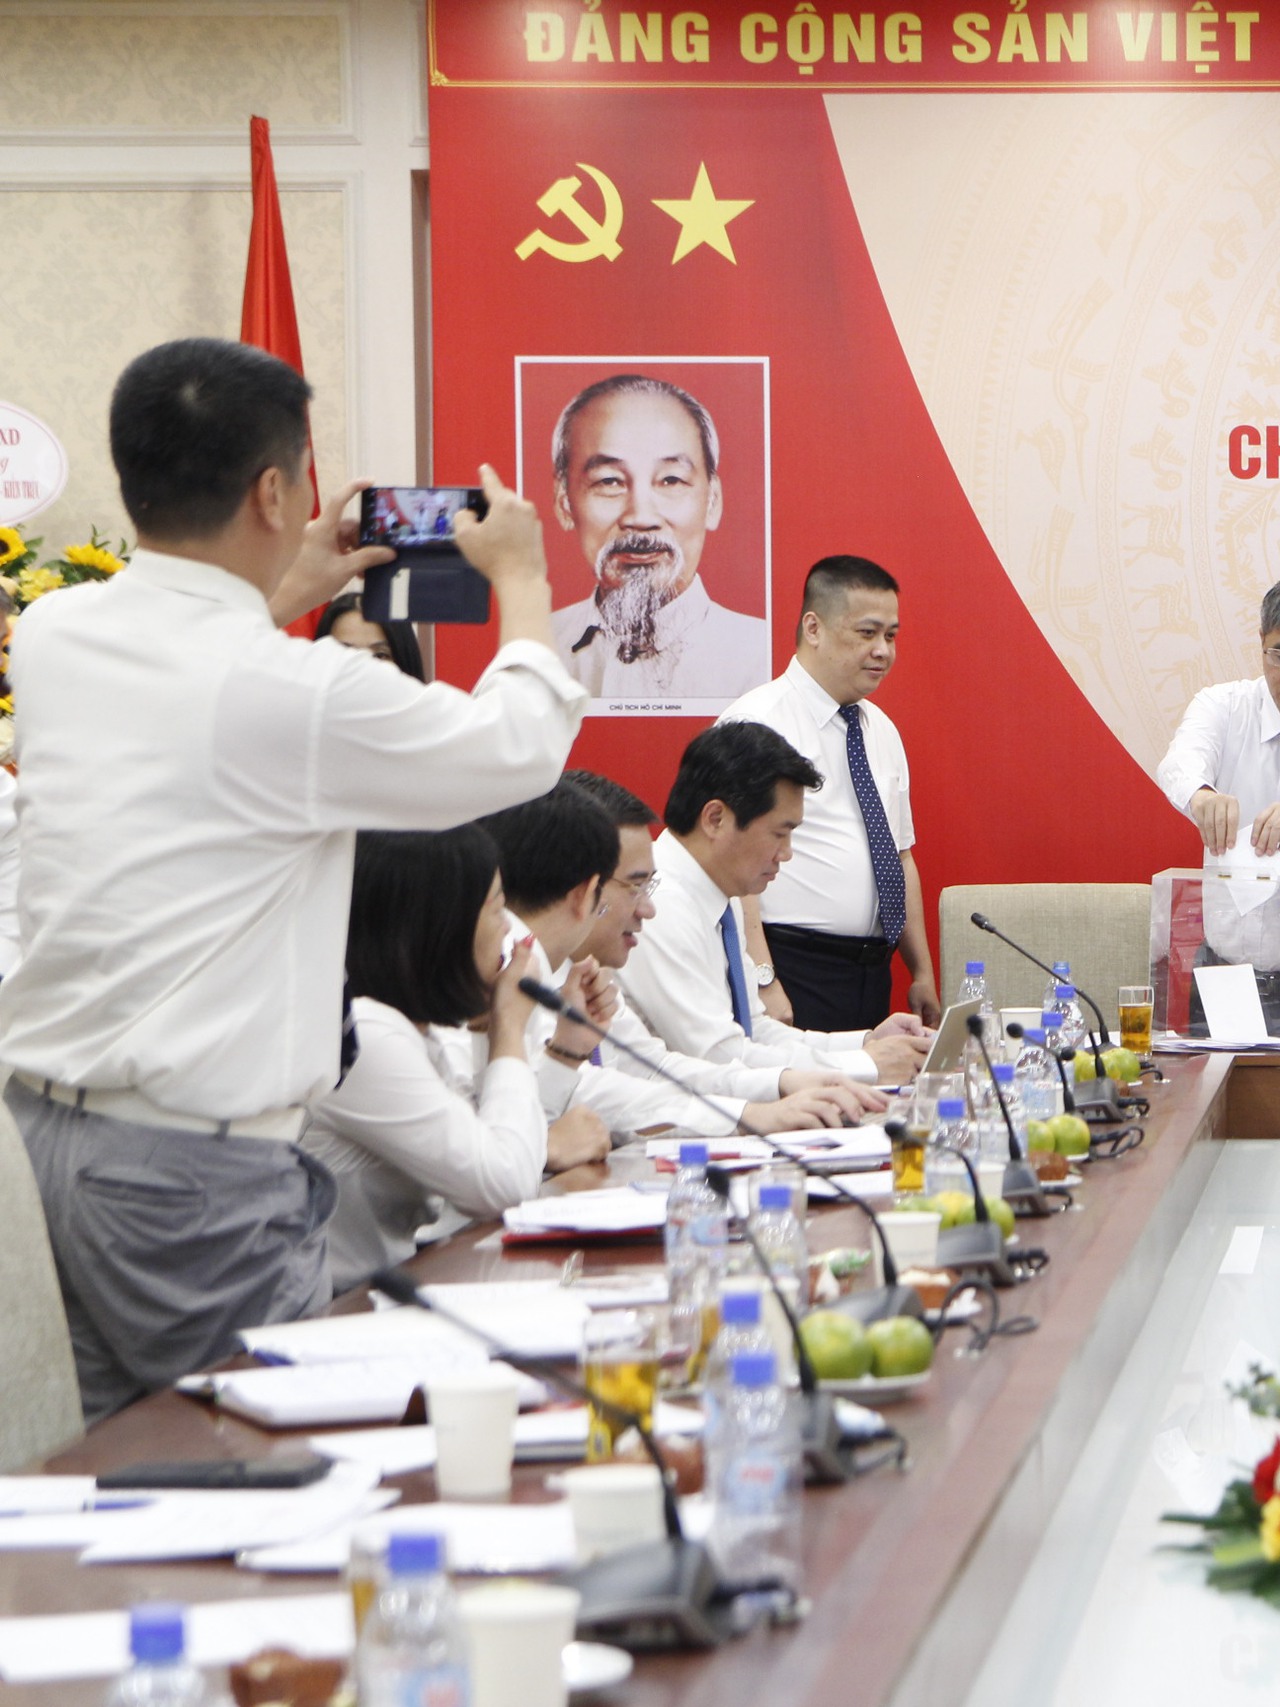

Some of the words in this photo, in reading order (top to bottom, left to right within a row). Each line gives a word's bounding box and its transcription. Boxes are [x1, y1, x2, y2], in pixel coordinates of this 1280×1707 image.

[524, 0, 709, 63] ĐẢNG
[740, 3, 922, 75] CỘNG
[952, 0, 1088, 63] SẢN
[1117, 0, 1260, 73] VIỆT
